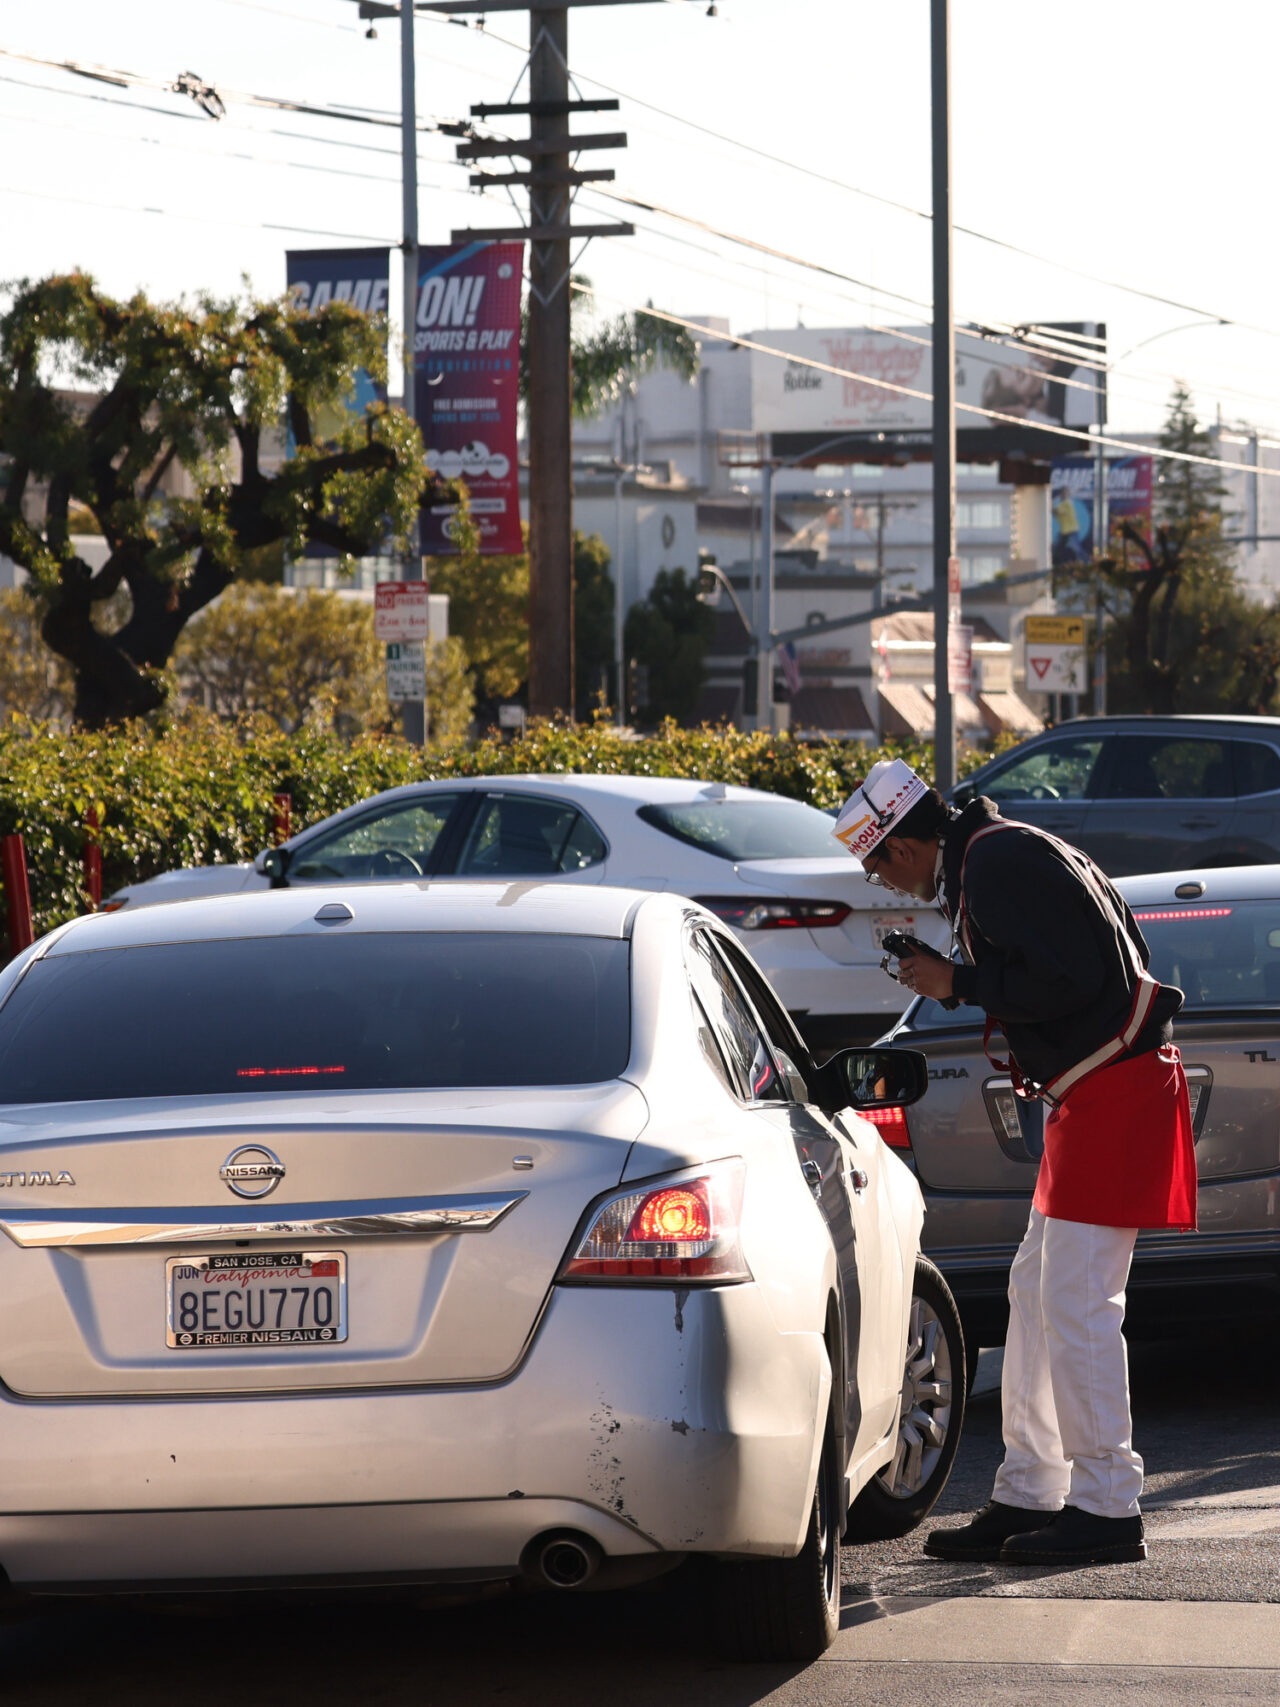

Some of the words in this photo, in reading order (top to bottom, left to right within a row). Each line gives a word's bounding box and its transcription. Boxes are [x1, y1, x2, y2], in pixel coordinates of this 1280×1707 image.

[416, 276, 485, 328] ON!
[415, 330, 465, 351] SPORTS
[479, 330, 514, 349] PLAY
[1243, 1050, 1276, 1063] TL
[226, 1166, 278, 1177] NISSAN
[214, 1257, 238, 1268] SAN
[242, 1255, 277, 1268] JOSE,
[281, 1255, 297, 1266] CA
[177, 1267, 199, 1280] JUN
[204, 1267, 308, 1289] California
[179, 1286, 332, 1332] 8EGU770
[251, 1329, 317, 1343] NISSAN
